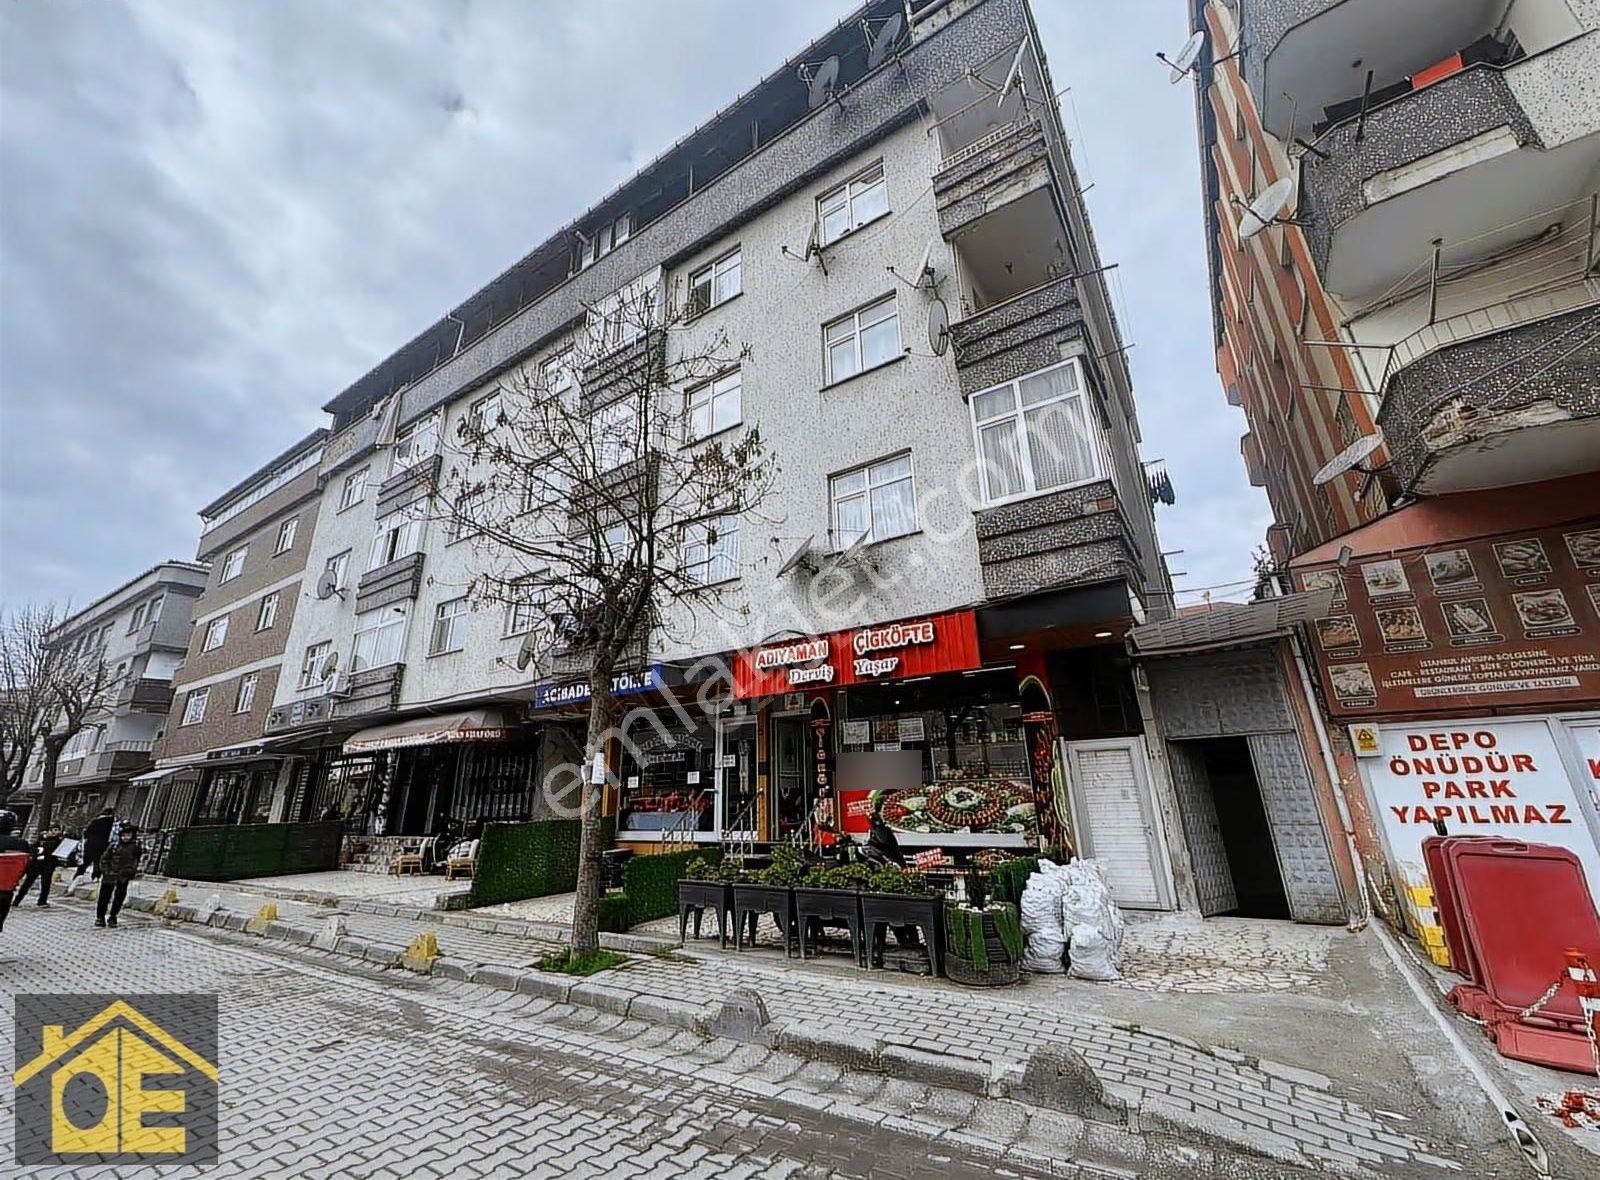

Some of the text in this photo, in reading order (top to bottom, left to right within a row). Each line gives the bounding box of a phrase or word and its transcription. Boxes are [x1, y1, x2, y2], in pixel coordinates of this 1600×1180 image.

[756, 640, 829, 669] ADIYAMAN
[789, 657, 898, 685] Derviş Yaşar
[1407, 731, 1497, 752] DEPO
[1389, 751, 1539, 776] ÖNÜDÜR
[1422, 779, 1517, 799] PARK
[1390, 804, 1573, 824] YAPILMAZ
